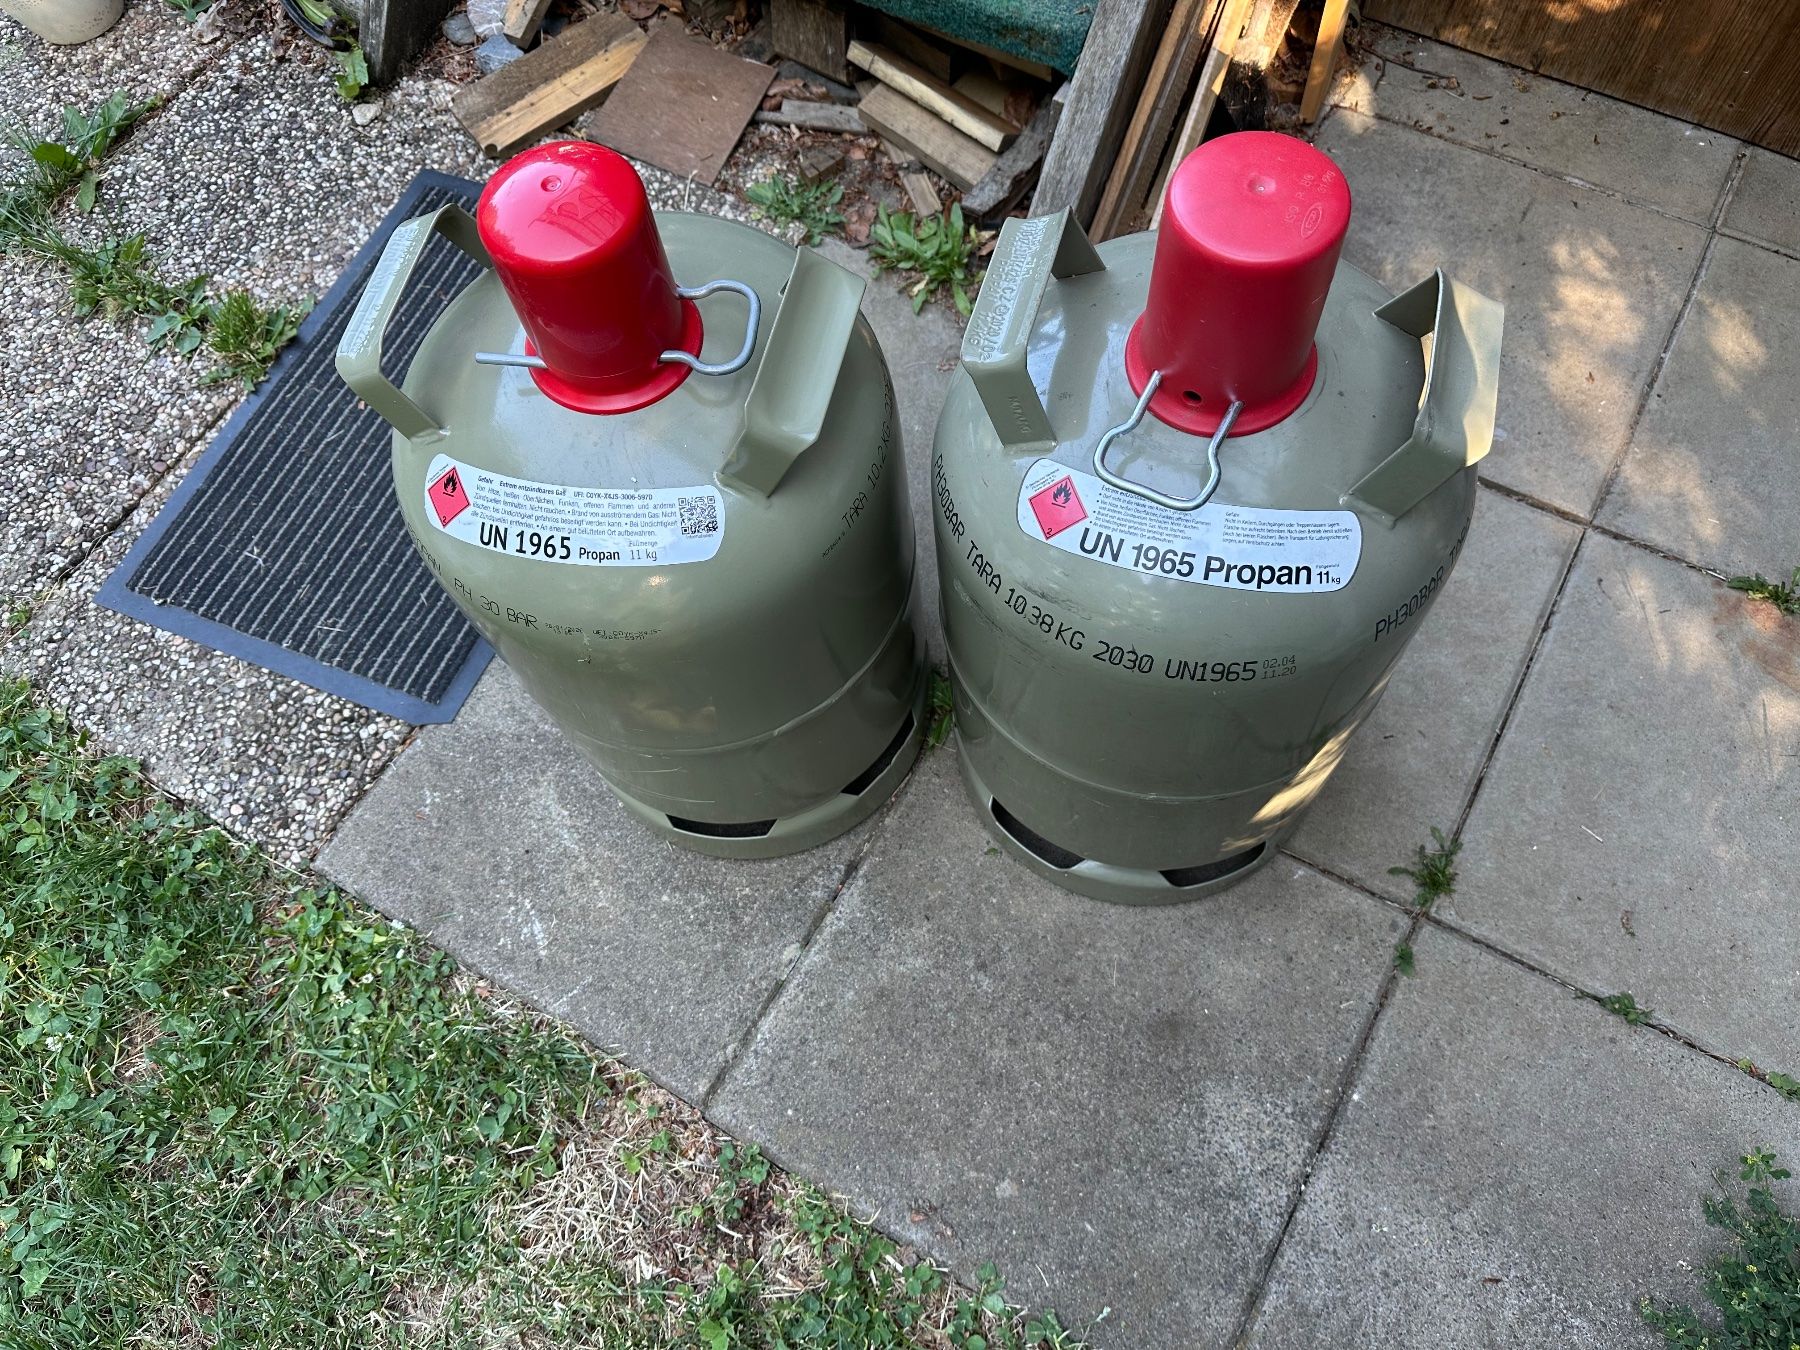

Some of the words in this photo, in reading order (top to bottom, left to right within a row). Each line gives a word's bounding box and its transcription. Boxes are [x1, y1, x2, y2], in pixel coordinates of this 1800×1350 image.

[841, 491, 869, 528] TARA
[867, 445, 888, 490] 10.2
[442, 515, 447, 524] 2
[480, 521, 508, 551] UN
[515, 530, 571, 560] 1965
[579, 547, 620, 563] Propan
[630, 549, 641, 560] 11
[645, 548, 657, 562] kg
[1046, 527, 1053, 536] 2
[934, 453, 965, 544] PH30BAR
[966, 539, 1002, 595] TARA
[1054, 621, 1086, 651] KG
[1092, 640, 1155, 674] 2030
[1164, 658, 1258, 682] UN1965
[1079, 527, 1125, 563] UN
[1132, 543, 1197, 578] 1965
[1203, 555, 1312, 590] Propan
[1317, 570, 1330, 585] 11
[1331, 576, 1341, 584] kg
[453, 578, 473, 602] PH
[479, 595, 501, 616] 30
[506, 607, 539, 631] BAR
[1374, 566, 1444, 642] PH30BAR
[1260, 665, 1297, 680] 11.20
[1262, 654, 1296, 670] 02.04
